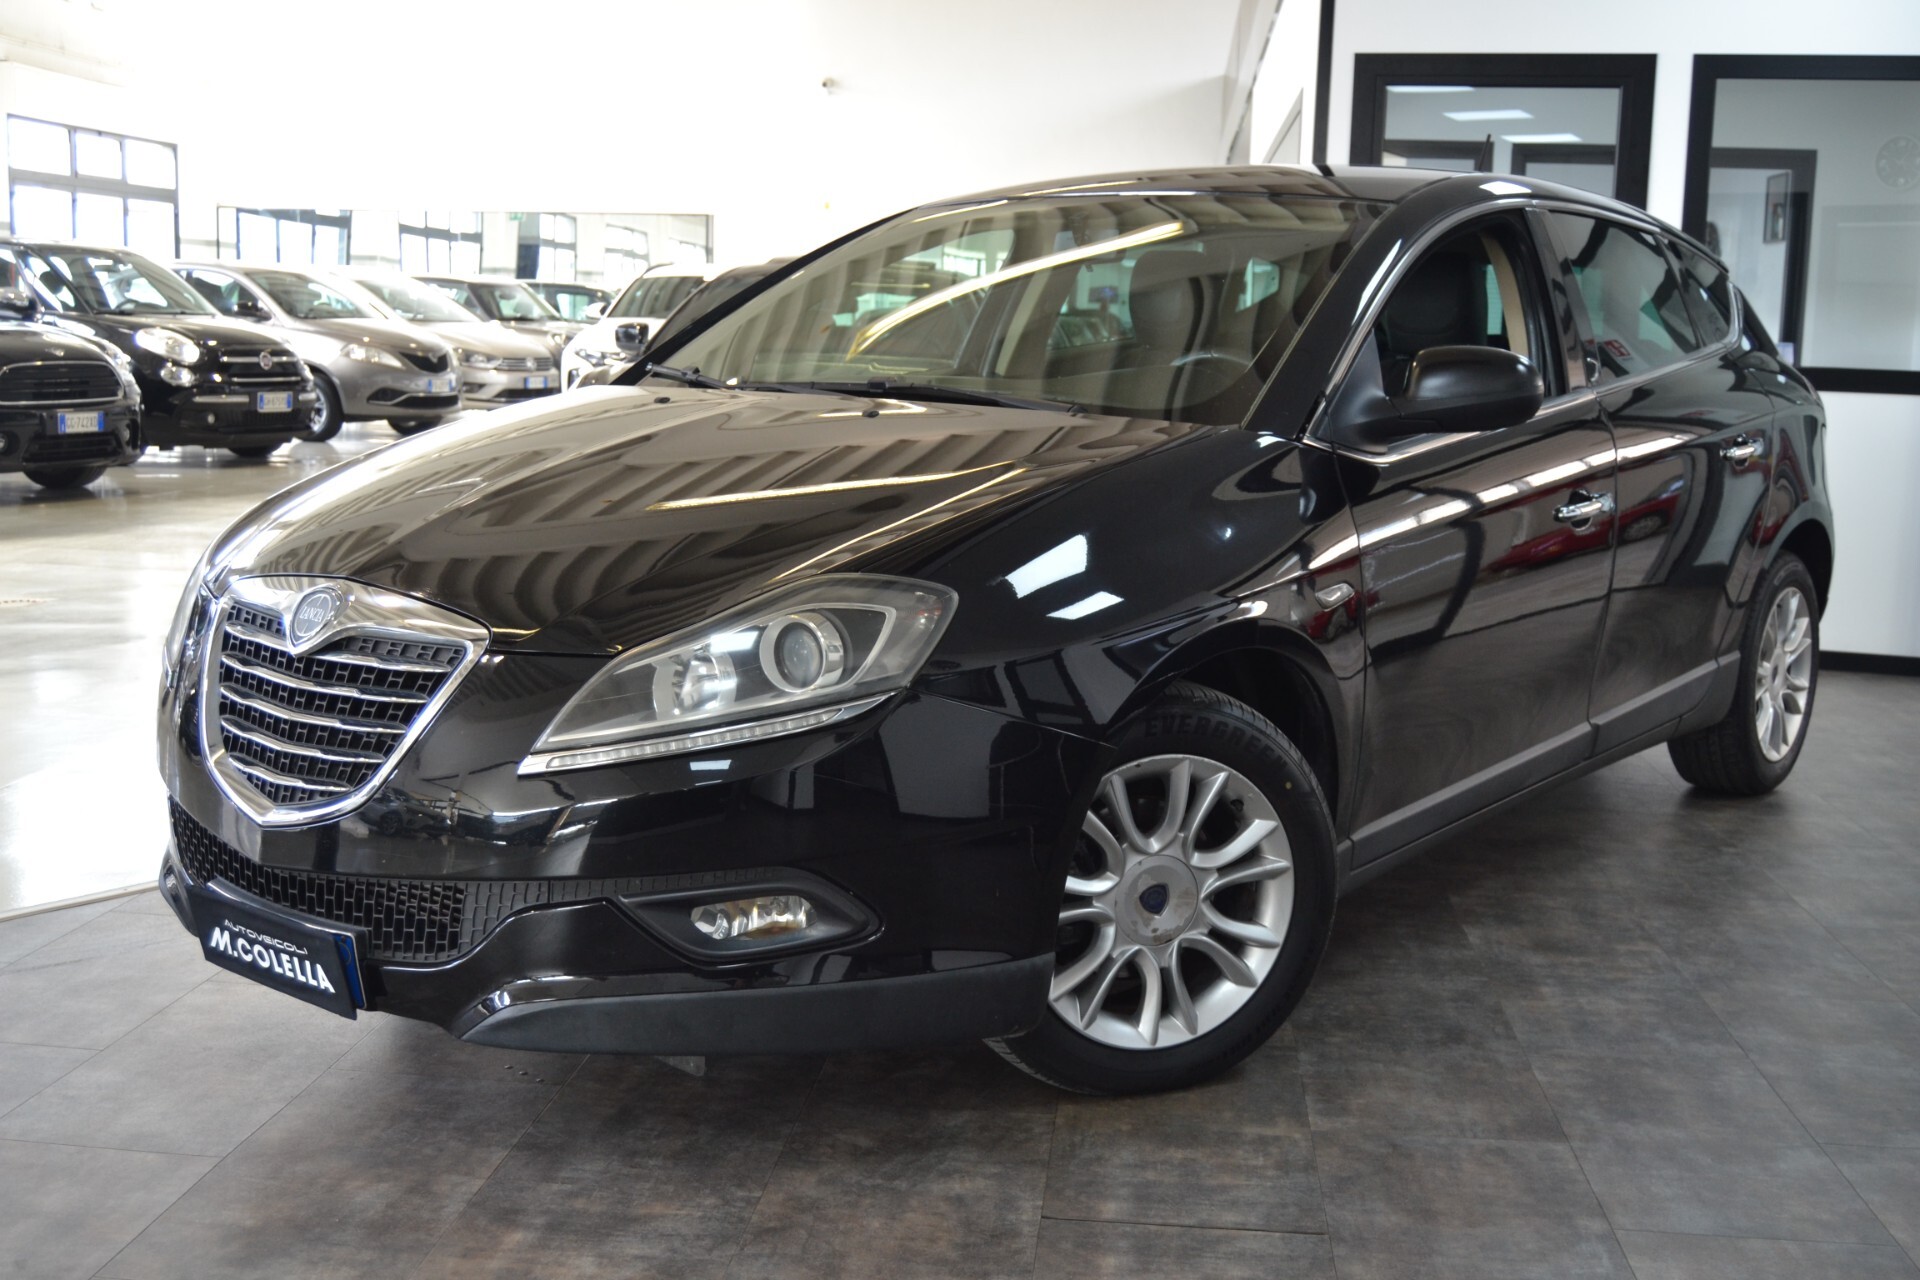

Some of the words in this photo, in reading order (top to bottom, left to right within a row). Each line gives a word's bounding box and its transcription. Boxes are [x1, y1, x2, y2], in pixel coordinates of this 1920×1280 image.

[1144, 715, 1288, 769] EVERGREEN
[210, 926, 336, 994] M.COLELLA
[224, 918, 308, 955] AUTOVEICOLI
